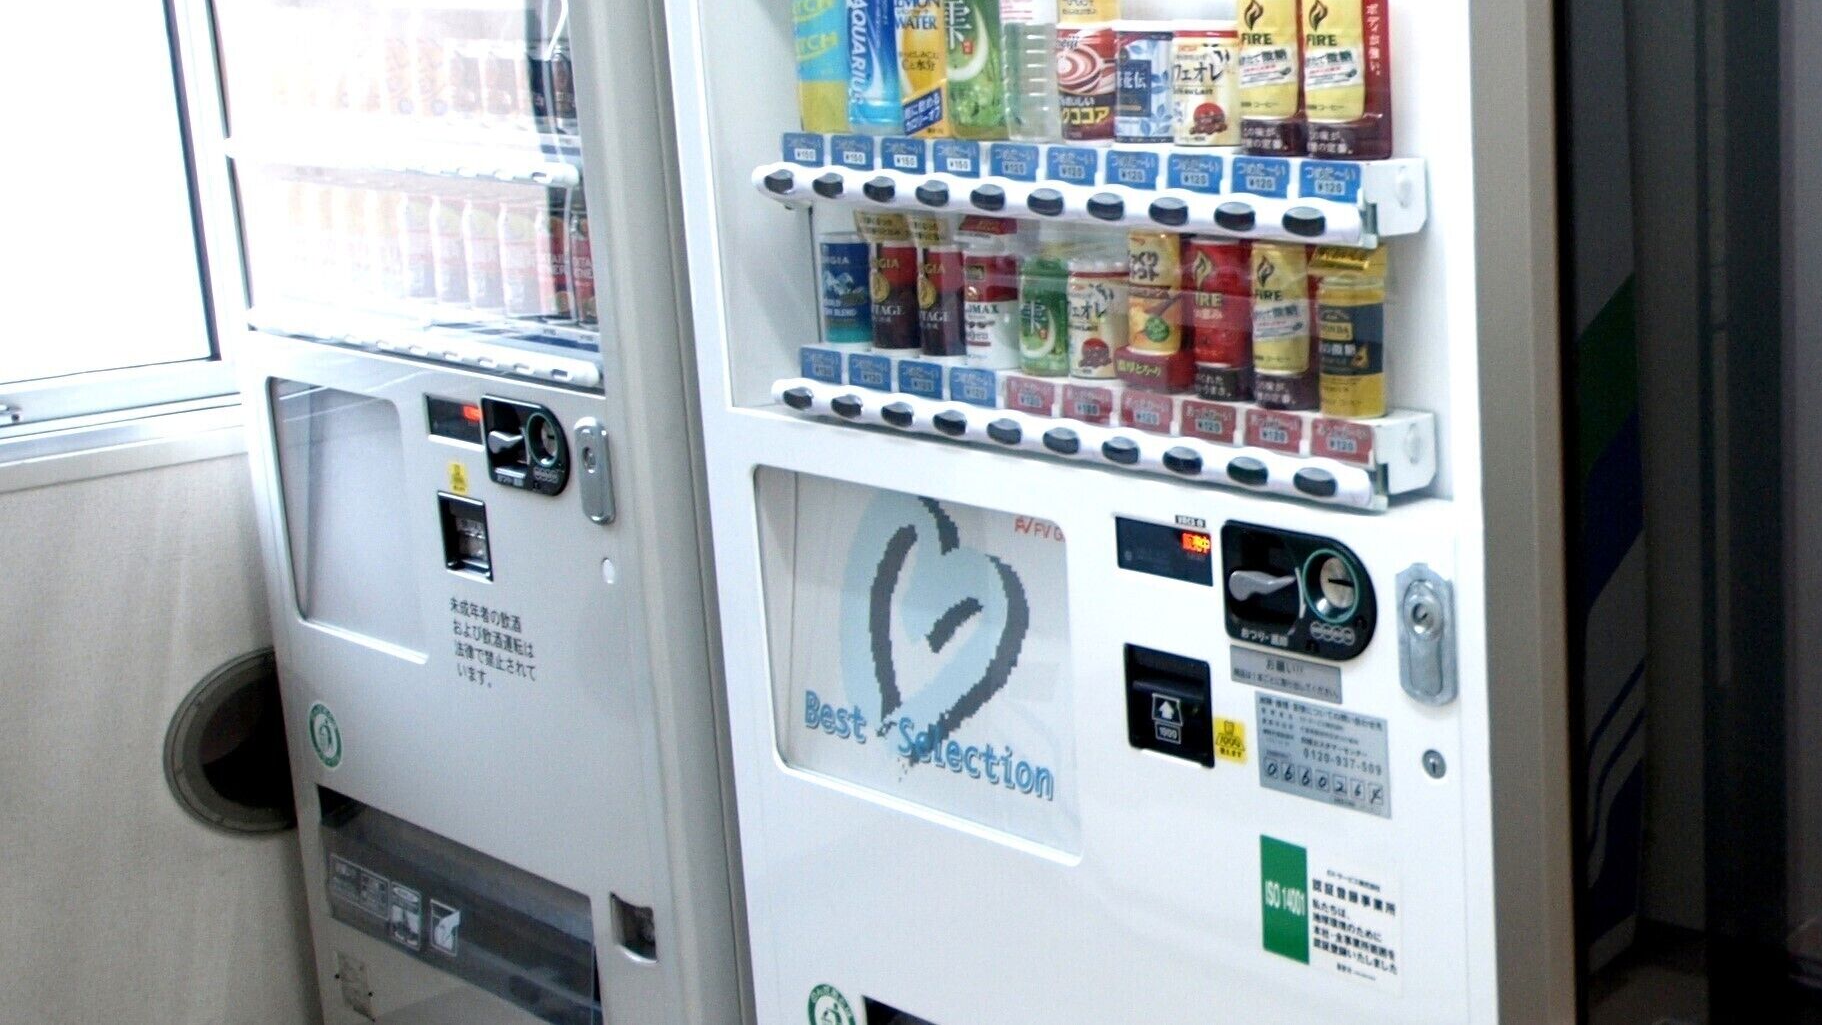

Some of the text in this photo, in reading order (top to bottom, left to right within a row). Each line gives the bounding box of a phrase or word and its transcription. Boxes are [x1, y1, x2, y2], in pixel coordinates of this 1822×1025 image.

[1241, 33, 1273, 45] FIRE
[1306, 34, 1338, 46] FIRE
[450, 597, 522, 634] 未成年者の飲酒
[453, 619, 534, 659] および飲酒運転は
[455, 639, 536, 682] 法律で禁止されて
[457, 662, 492, 688] います。
[805, 690, 1055, 801] Best Selection
[1265, 879, 1281, 909] ISO
